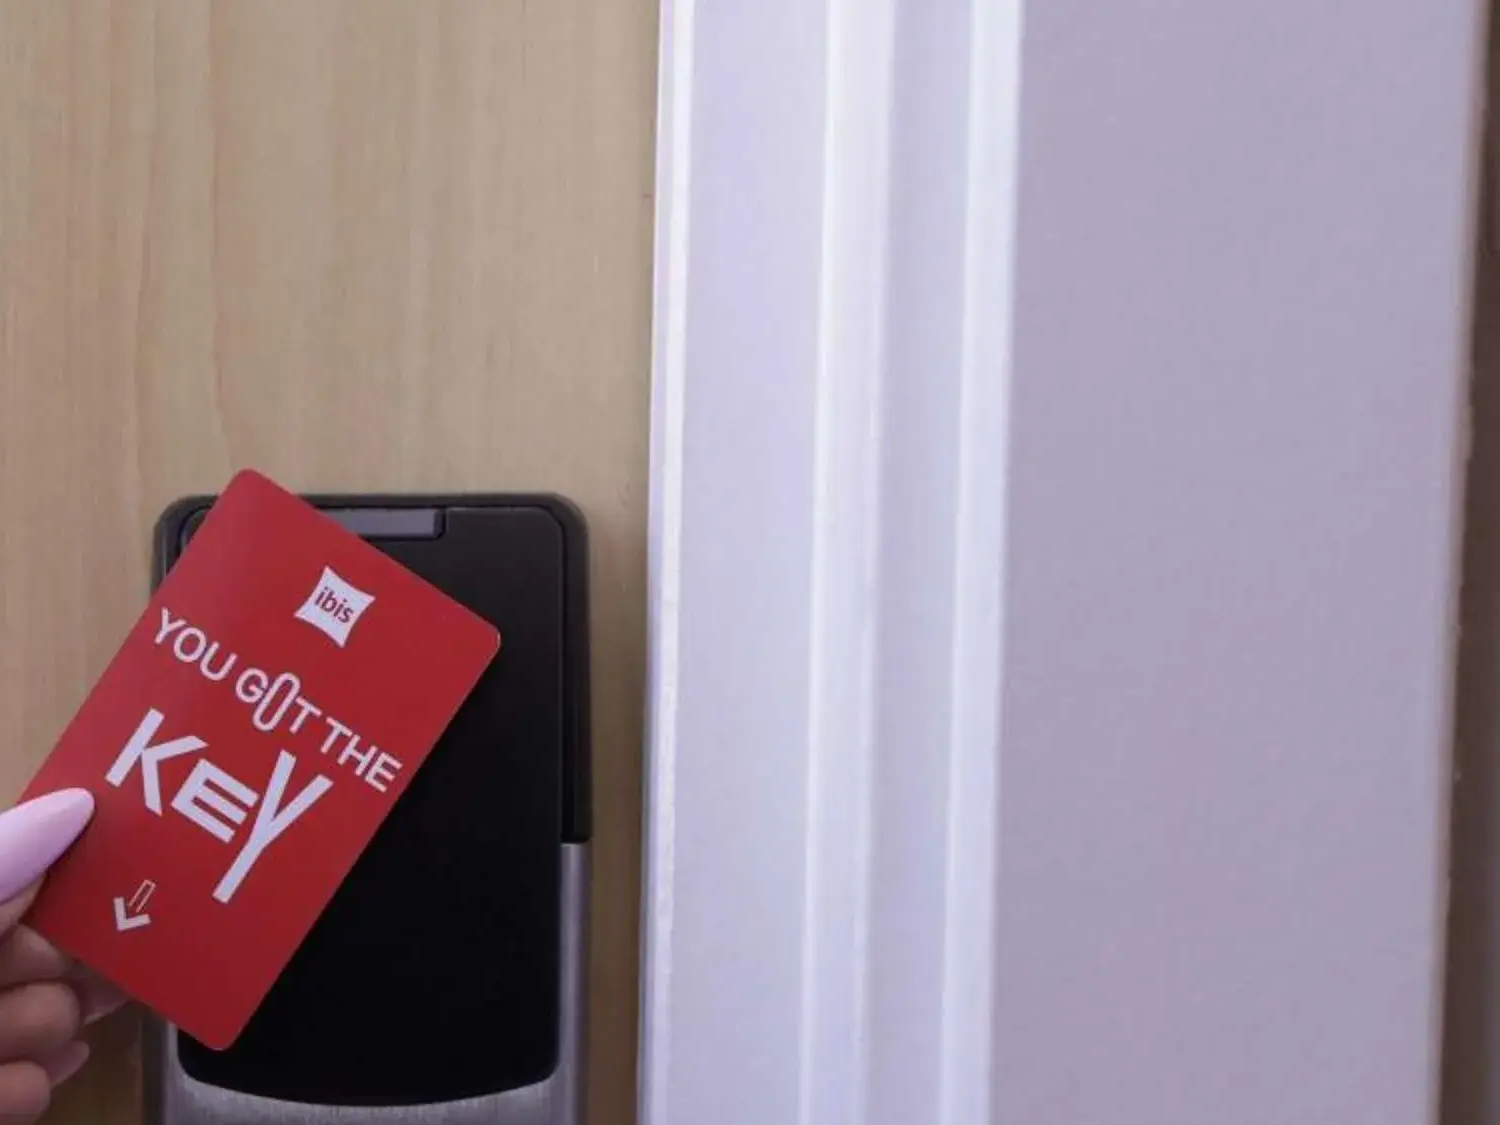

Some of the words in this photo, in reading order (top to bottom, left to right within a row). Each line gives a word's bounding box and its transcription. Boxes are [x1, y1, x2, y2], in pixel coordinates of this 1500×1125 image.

[314, 585, 355, 624] ibis
[154, 607, 237, 681] YOU
[235, 668, 322, 733] GOT
[320, 717, 403, 793] THE
[105, 707, 334, 904] KEY
